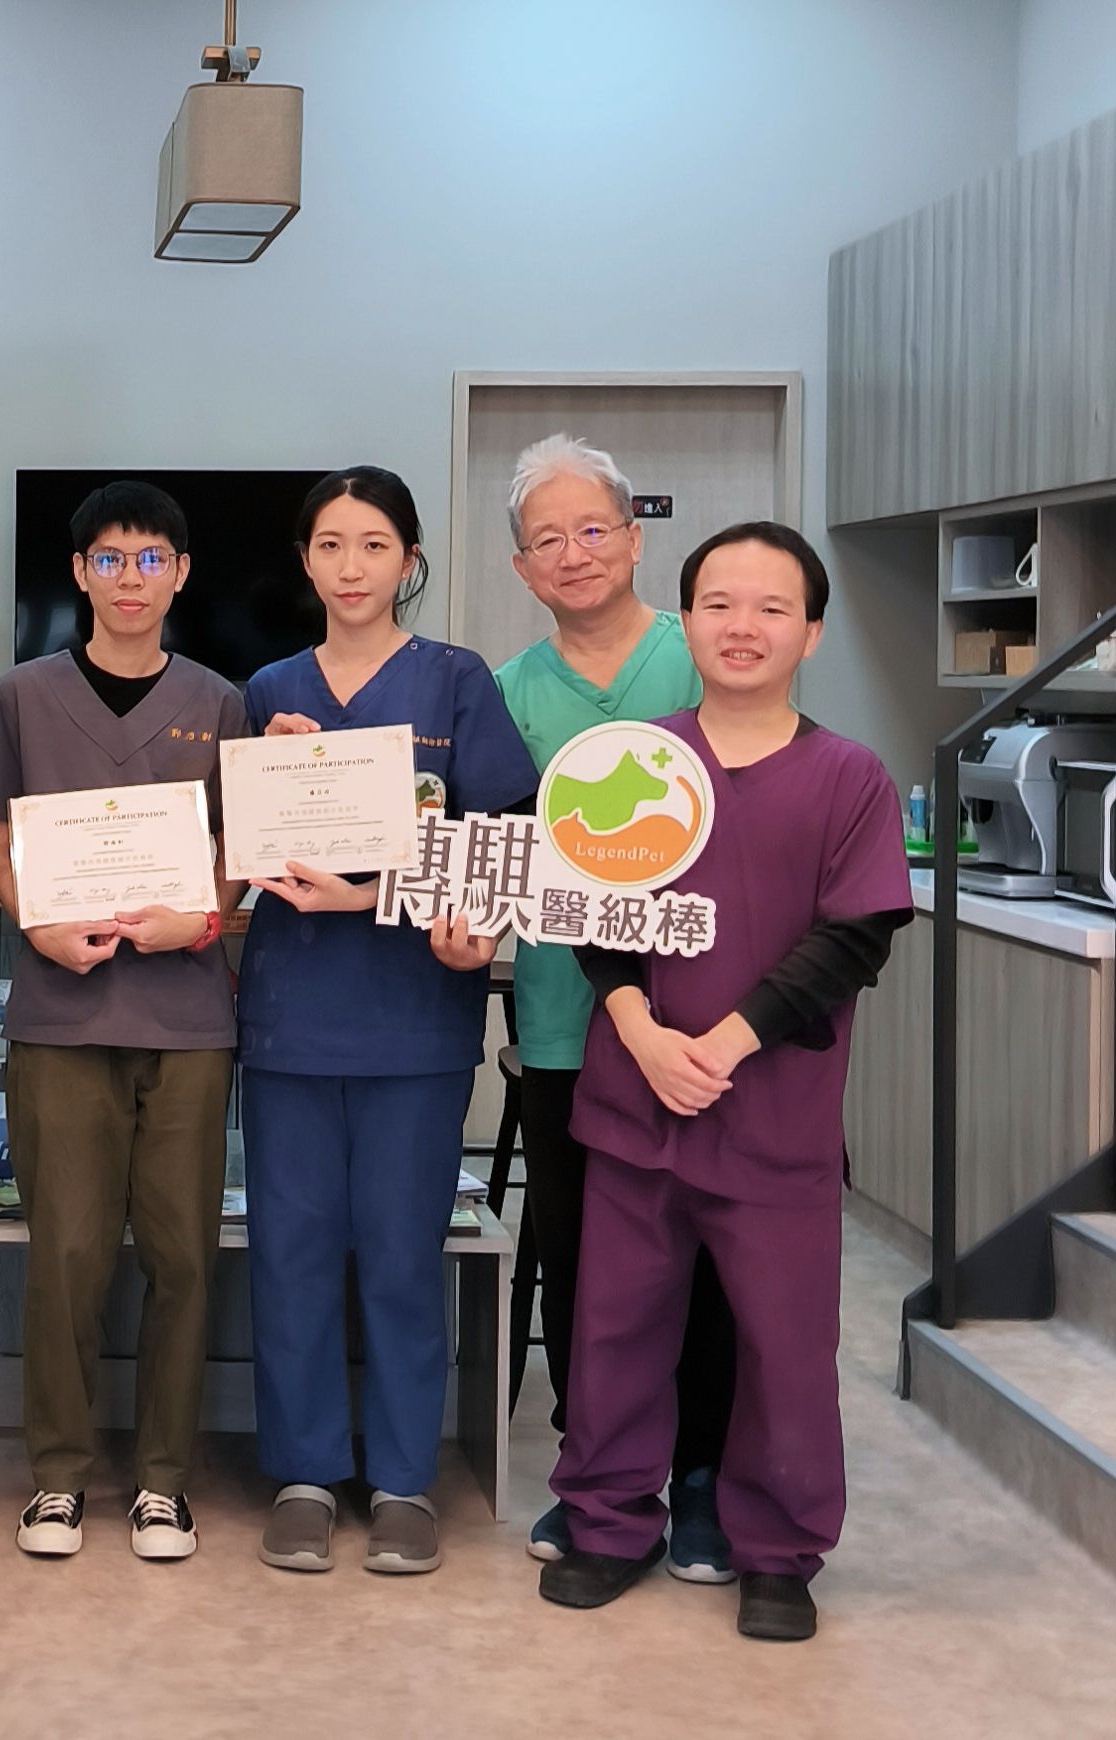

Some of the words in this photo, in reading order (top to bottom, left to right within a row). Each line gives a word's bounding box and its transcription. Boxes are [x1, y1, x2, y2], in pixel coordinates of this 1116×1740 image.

[262, 763, 305, 773] CERTIFICATE
[319, 758, 375, 769] PARTICIPATION
[55, 816, 100, 826] CERTIFICATE
[112, 811, 168, 821] PARTICIPATION
[575, 841, 665, 862] LegendPet
